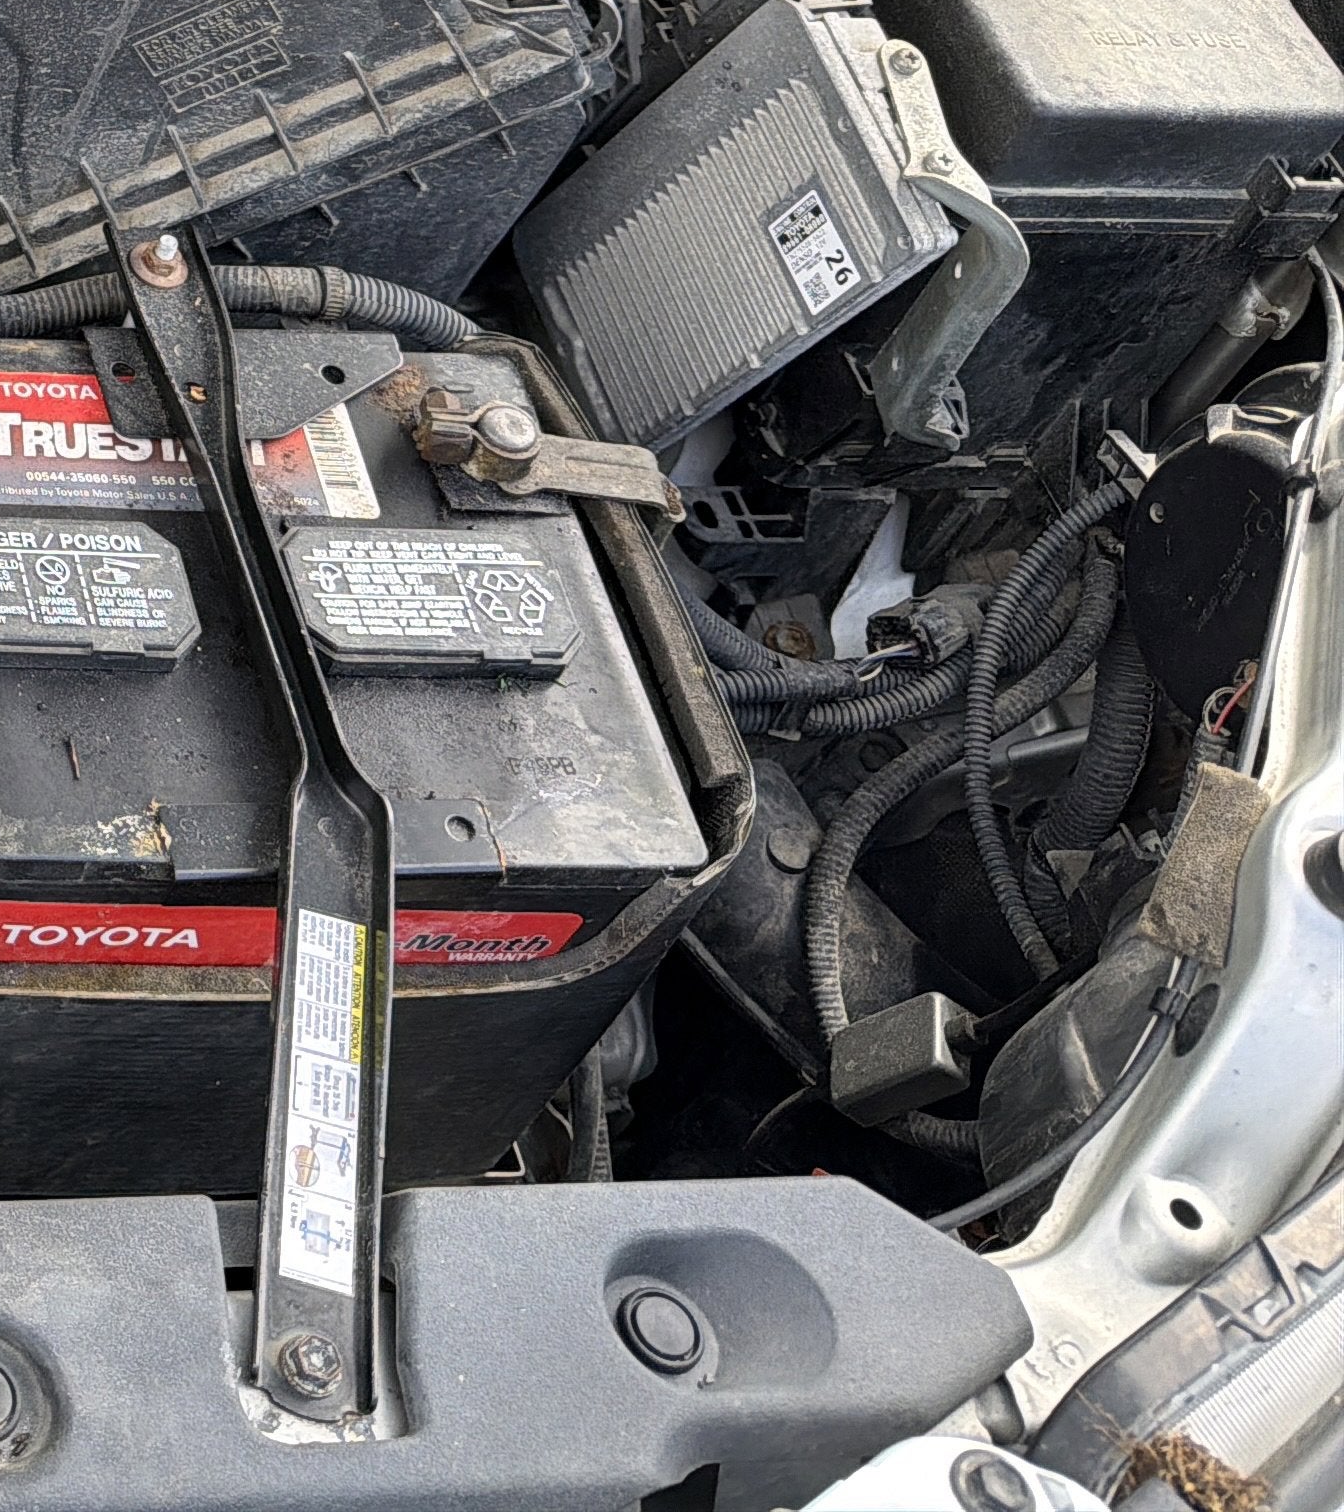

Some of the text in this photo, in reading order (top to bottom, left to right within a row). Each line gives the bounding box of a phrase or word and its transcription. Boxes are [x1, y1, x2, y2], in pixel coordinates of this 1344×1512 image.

[1089, 31, 1161, 47] RELAY
[1187, 32, 1247, 48] FUSE
[784, 212, 814, 238] TOYOTA
[825, 248, 854, 286] 26
[25, 471, 175, 486] 00544-35060-550 550
[40, 487, 54, 498] by
[55, 488, 90, 500] Toyota
[92, 489, 124, 499] Motor
[126, 490, 154, 500] Sales
[41, 533, 56, 548] /
[59, 533, 142, 552] POISON
[329, 541, 352, 550] KEEP
[354, 541, 373, 550] OUT
[375, 541, 389, 550] OF
[373, 563, 395, 573] EYES
[45, 585, 65, 596] NO
[91, 586, 173, 600] SULFURIC ACID
[38, 596, 77, 607] SPARKS
[93, 598, 148, 609] CAN CAUSE
[40, 605, 78, 616] FLAMES
[96, 607, 151, 618] BLINDNESS
[43, 615, 87, 626] SMOKING
[98, 617, 135, 627] SEVERE
[0, 923, 200, 949] TOYOTA
[448, 952, 538, 962] WARRANTY
[351, 933, 365, 1009] CAUTION ATTENTION
